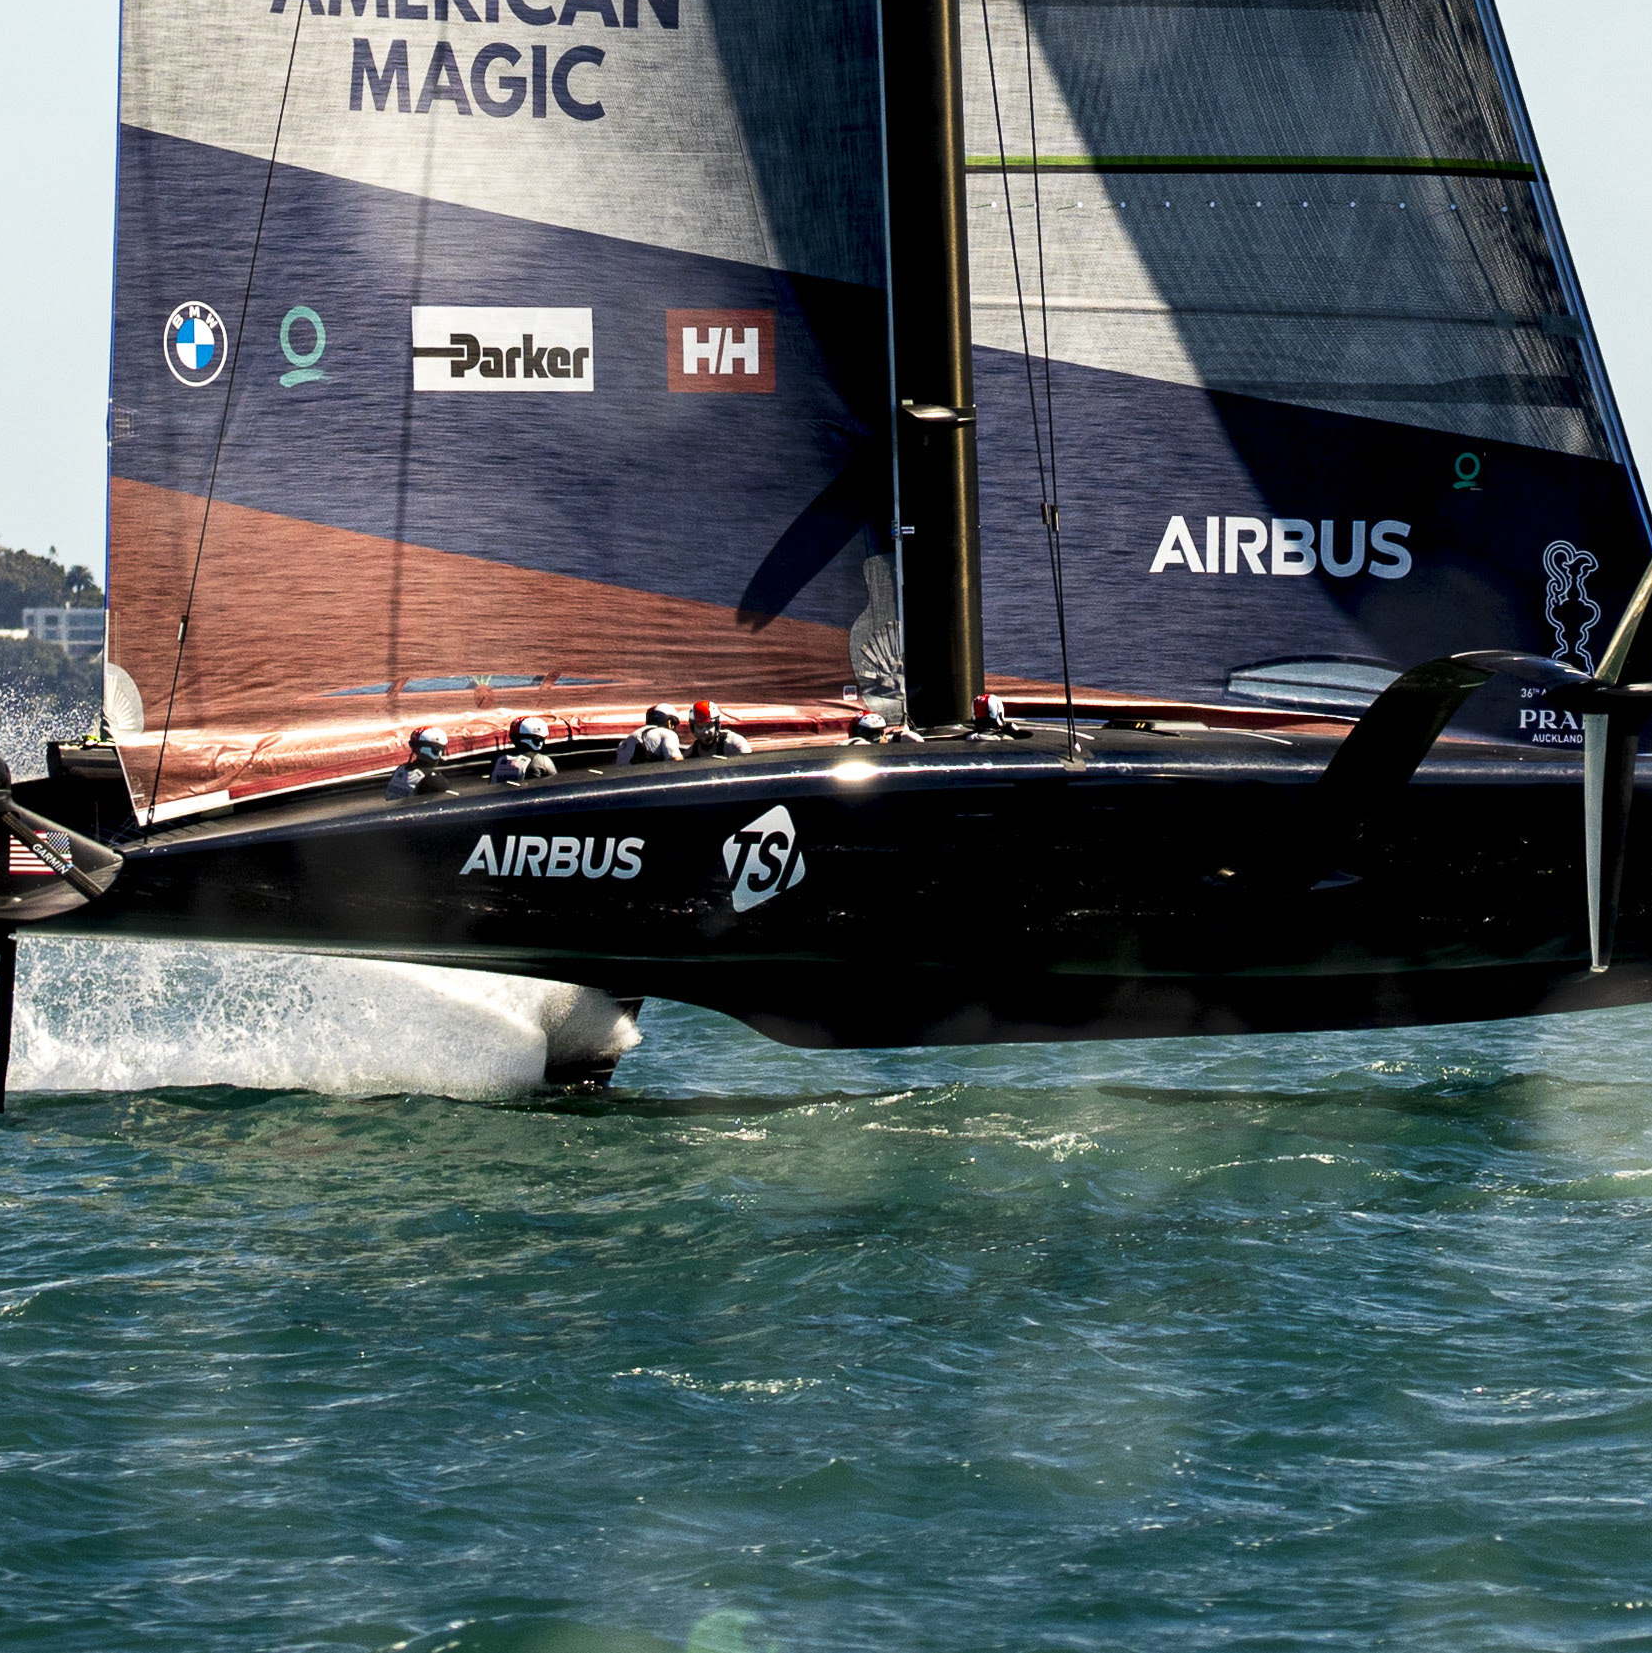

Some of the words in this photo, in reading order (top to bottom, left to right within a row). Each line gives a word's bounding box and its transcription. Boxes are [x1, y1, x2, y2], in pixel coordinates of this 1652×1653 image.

[348, 38, 607, 122] MAGIC
[171, 305, 219, 330] BMW
[450, 333, 589, 378] Parker
[1149, 515, 1413, 579] AIRBUS
[1519, 709, 1585, 729] PRA
[1532, 733, 1584, 744] AUCKLAND
[32, 843, 69, 875] GARMIN
[459, 835, 645, 879] AIRBUS
[730, 830, 801, 893] TSI
